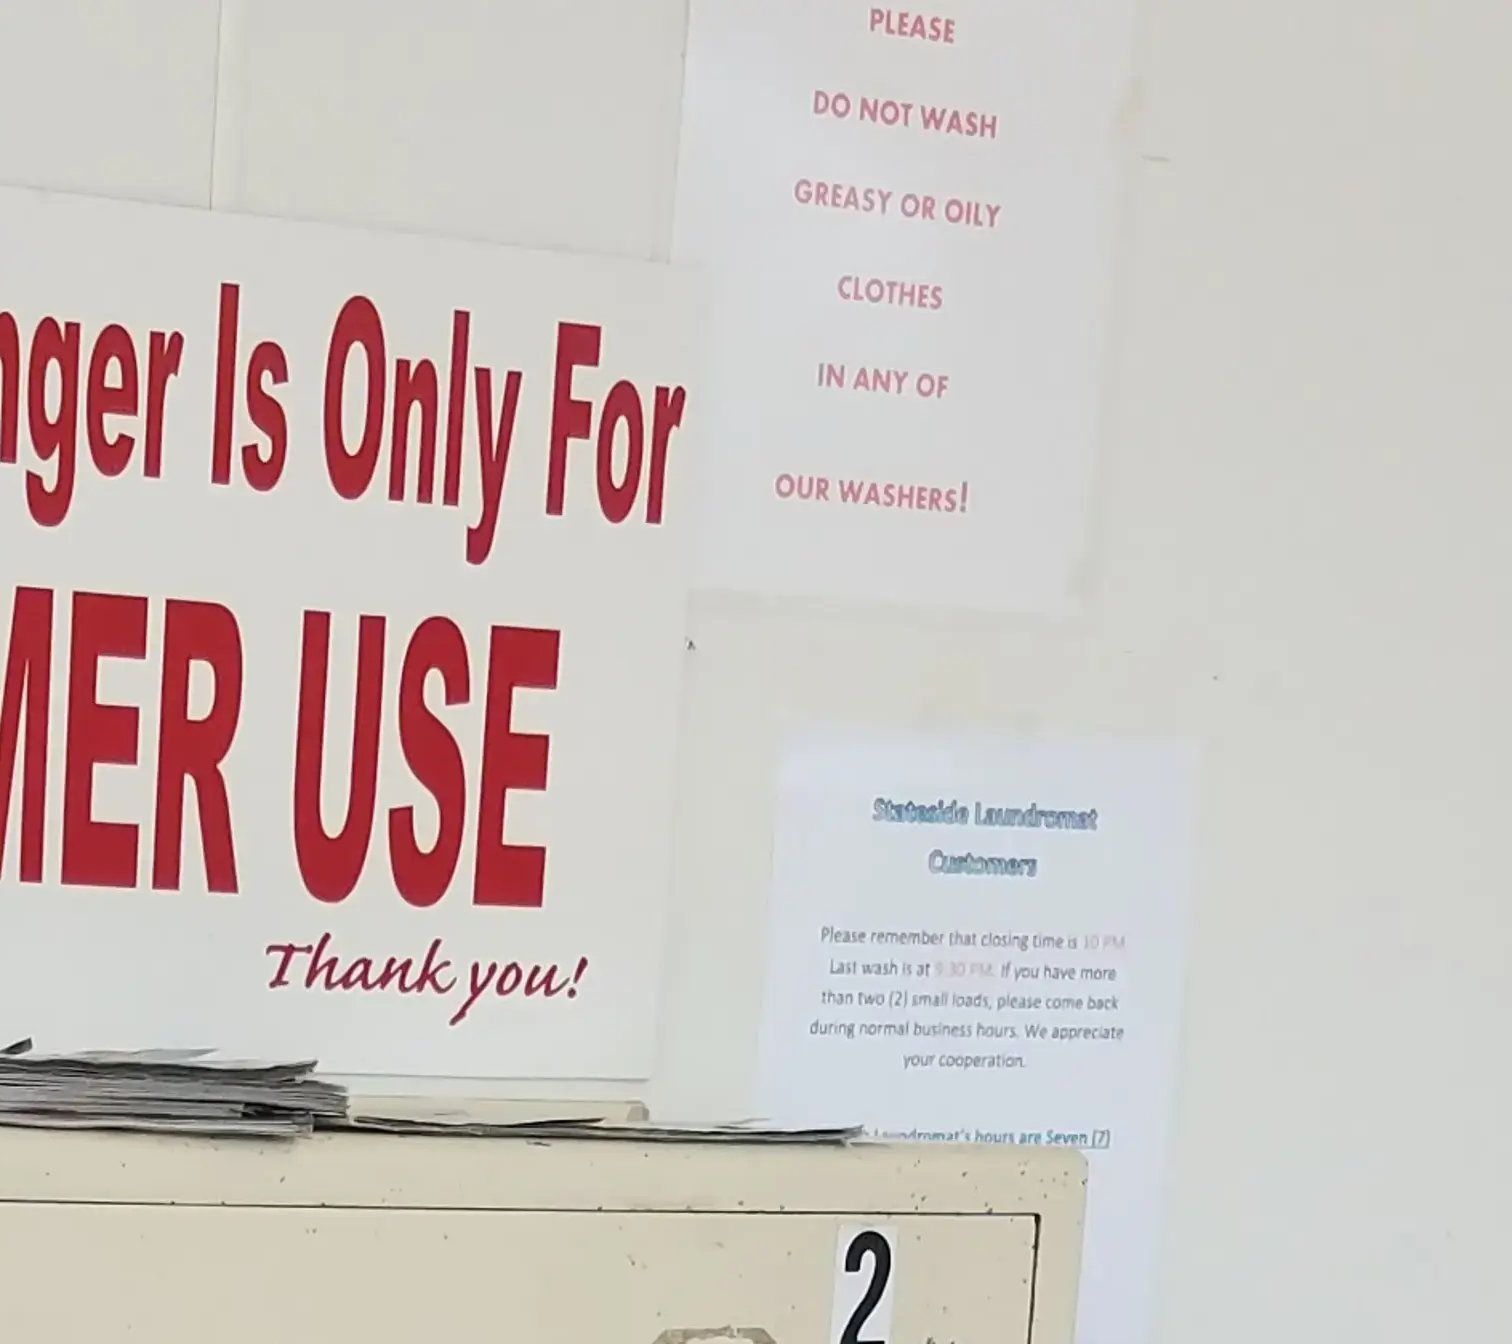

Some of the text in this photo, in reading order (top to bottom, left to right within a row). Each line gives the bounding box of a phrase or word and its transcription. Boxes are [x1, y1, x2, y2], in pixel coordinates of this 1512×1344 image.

[870, 8, 955, 44] PLEASE
[812, 89, 998, 139] DO NOT WASH
[794, 178, 1002, 228] GREASY OR OILY
[837, 275, 944, 310] CLOTHES
[817, 362, 949, 399] IN ANY OF
[210, 281, 289, 493] Is
[322, 294, 524, 566] Only
[545, 320, 687, 526] For
[774, 473, 969, 514] OUR WASHERS!
[292, 608, 562, 909] USE
[928, 849, 1038, 877] Customers
[821, 926, 867, 944] Please
[870, 931, 944, 946] remember
[949, 931, 977, 946] that
[981, 933, 1028, 951] closing
[1032, 933, 1064, 948] time
[1068, 935, 1077, 949] is
[265, 931, 589, 1027] Thank you!
[829, 959, 857, 975] Last
[862, 960, 898, 976] wash
[902, 961, 912, 976] is
[916, 963, 930, 976] at
[1014, 967, 1039, 982] you
[1043, 965, 1076, 980] have
[1080, 968, 1116, 981] more
[821, 991, 853, 1005] than
[857, 992, 885, 1005] two
[890, 991, 908, 1007] (2)
[912, 991, 948, 1007] small
[997, 995, 1041, 1011] please
[1045, 997, 1084, 1010] come
[1087, 995, 1119, 1011] back
[810, 1019, 855, 1039] during
[859, 1021, 909, 1036] normal
[913, 1022, 972, 1037] business
[1024, 1024, 1048, 1039] We
[1051, 1024, 1124, 1041] appreciate
[903, 1053, 935, 1070] your
